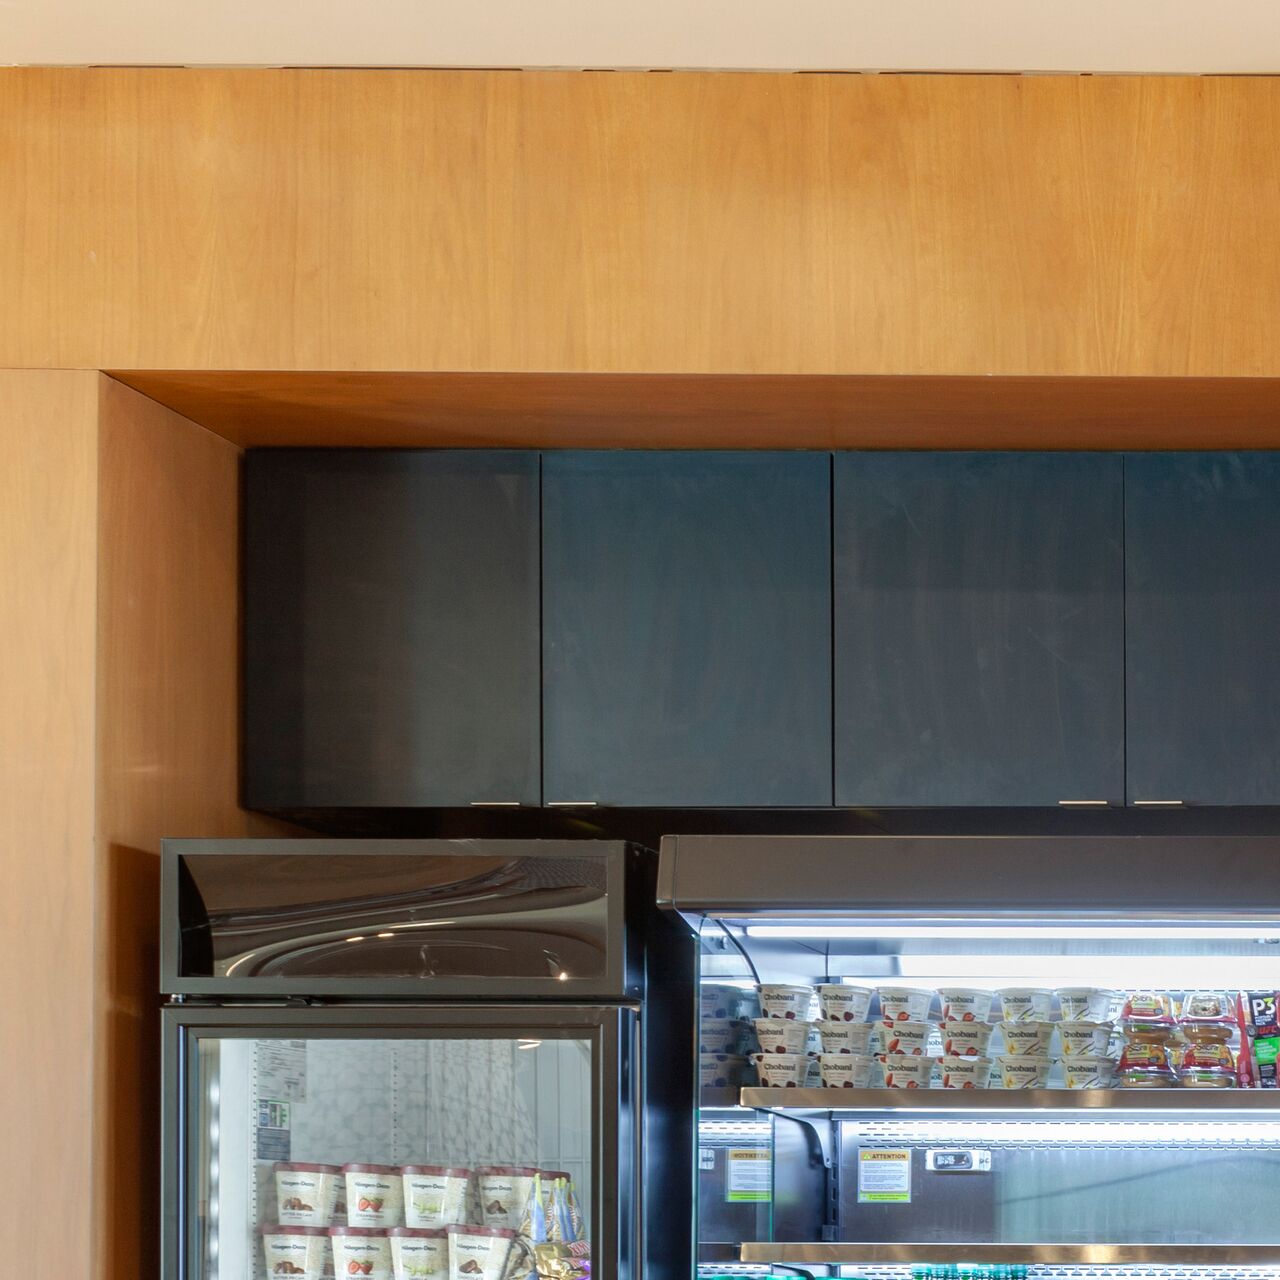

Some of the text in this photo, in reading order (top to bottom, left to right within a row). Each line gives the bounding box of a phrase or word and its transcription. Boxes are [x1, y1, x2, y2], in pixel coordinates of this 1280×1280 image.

[763, 993, 795, 1002] Chobani
[822, 993, 853, 1002] Chobani
[1253, 997, 1276, 1016] P3
[893, 1030, 924, 1039] Chobani
[946, 1031, 978, 1039] Chobani
[1007, 1030, 1038, 1039] Chobani
[764, 1063, 796, 1072] Chobani
[823, 1063, 853, 1072] Chobani
[887, 1064, 919, 1073] Chobani
[944, 1065, 974, 1073] Chobani
[1006, 1065, 1037, 1074] Chobani
[1067, 1065, 1098, 1074] Chobani
